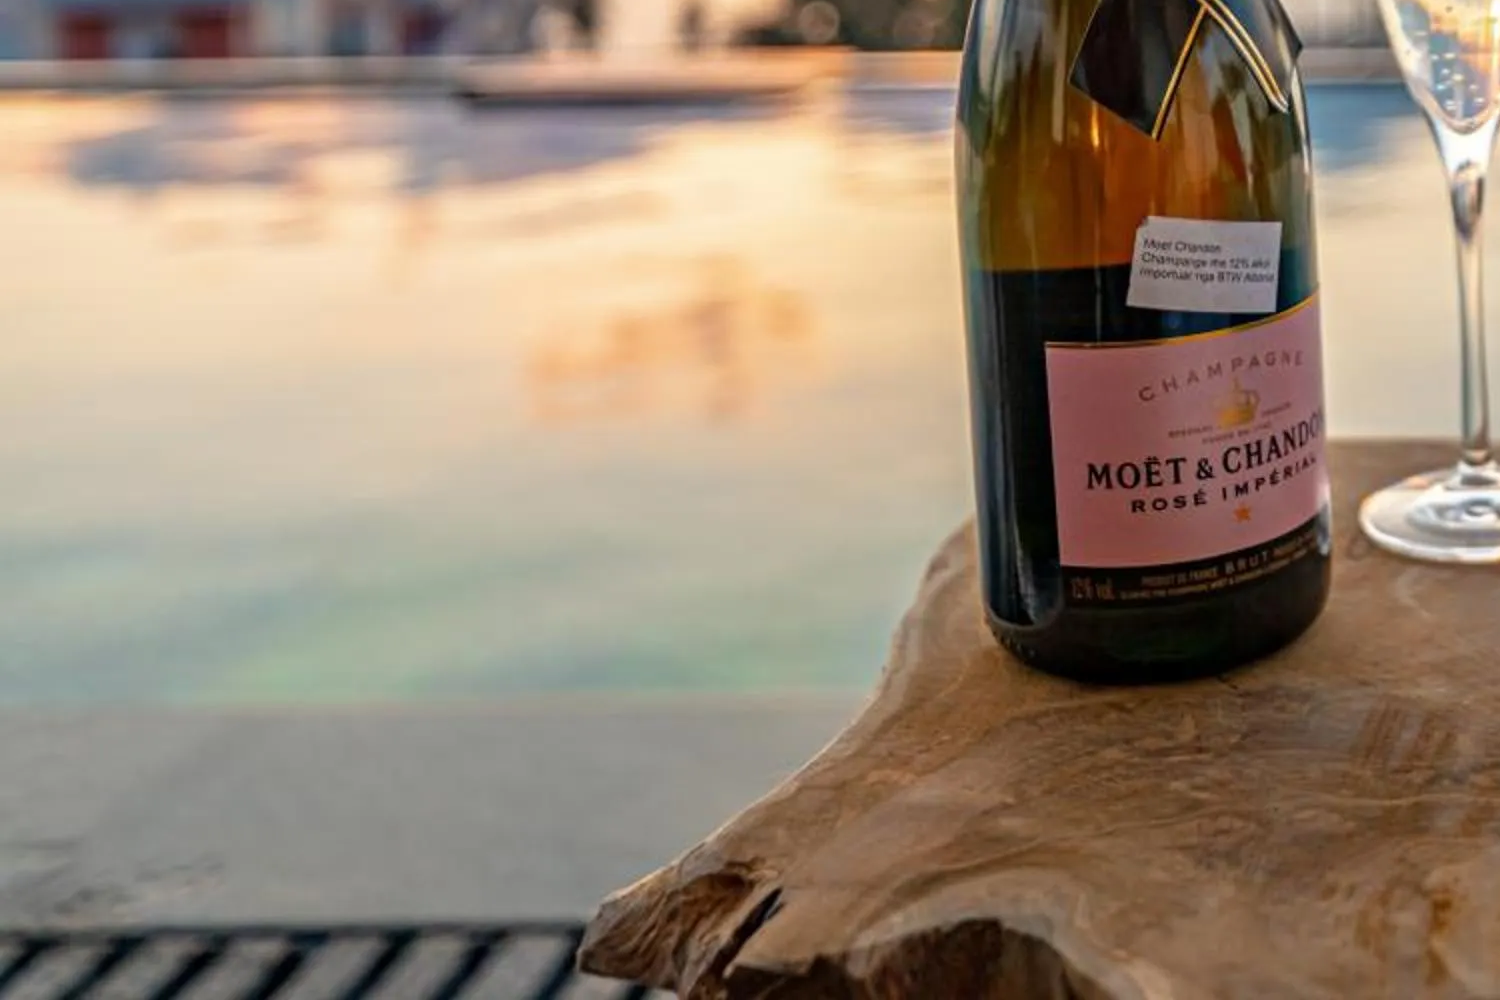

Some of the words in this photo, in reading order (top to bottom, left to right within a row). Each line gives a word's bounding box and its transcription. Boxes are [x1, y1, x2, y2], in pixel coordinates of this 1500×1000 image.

[1137, 349, 1304, 403] CHAMPAGNE
[1086, 456, 1188, 490] MOËT
[1195, 457, 1216, 482] &
[1130, 489, 1208, 514] ROSÉ
[1221, 456, 1318, 501] IMPÉRIAL
